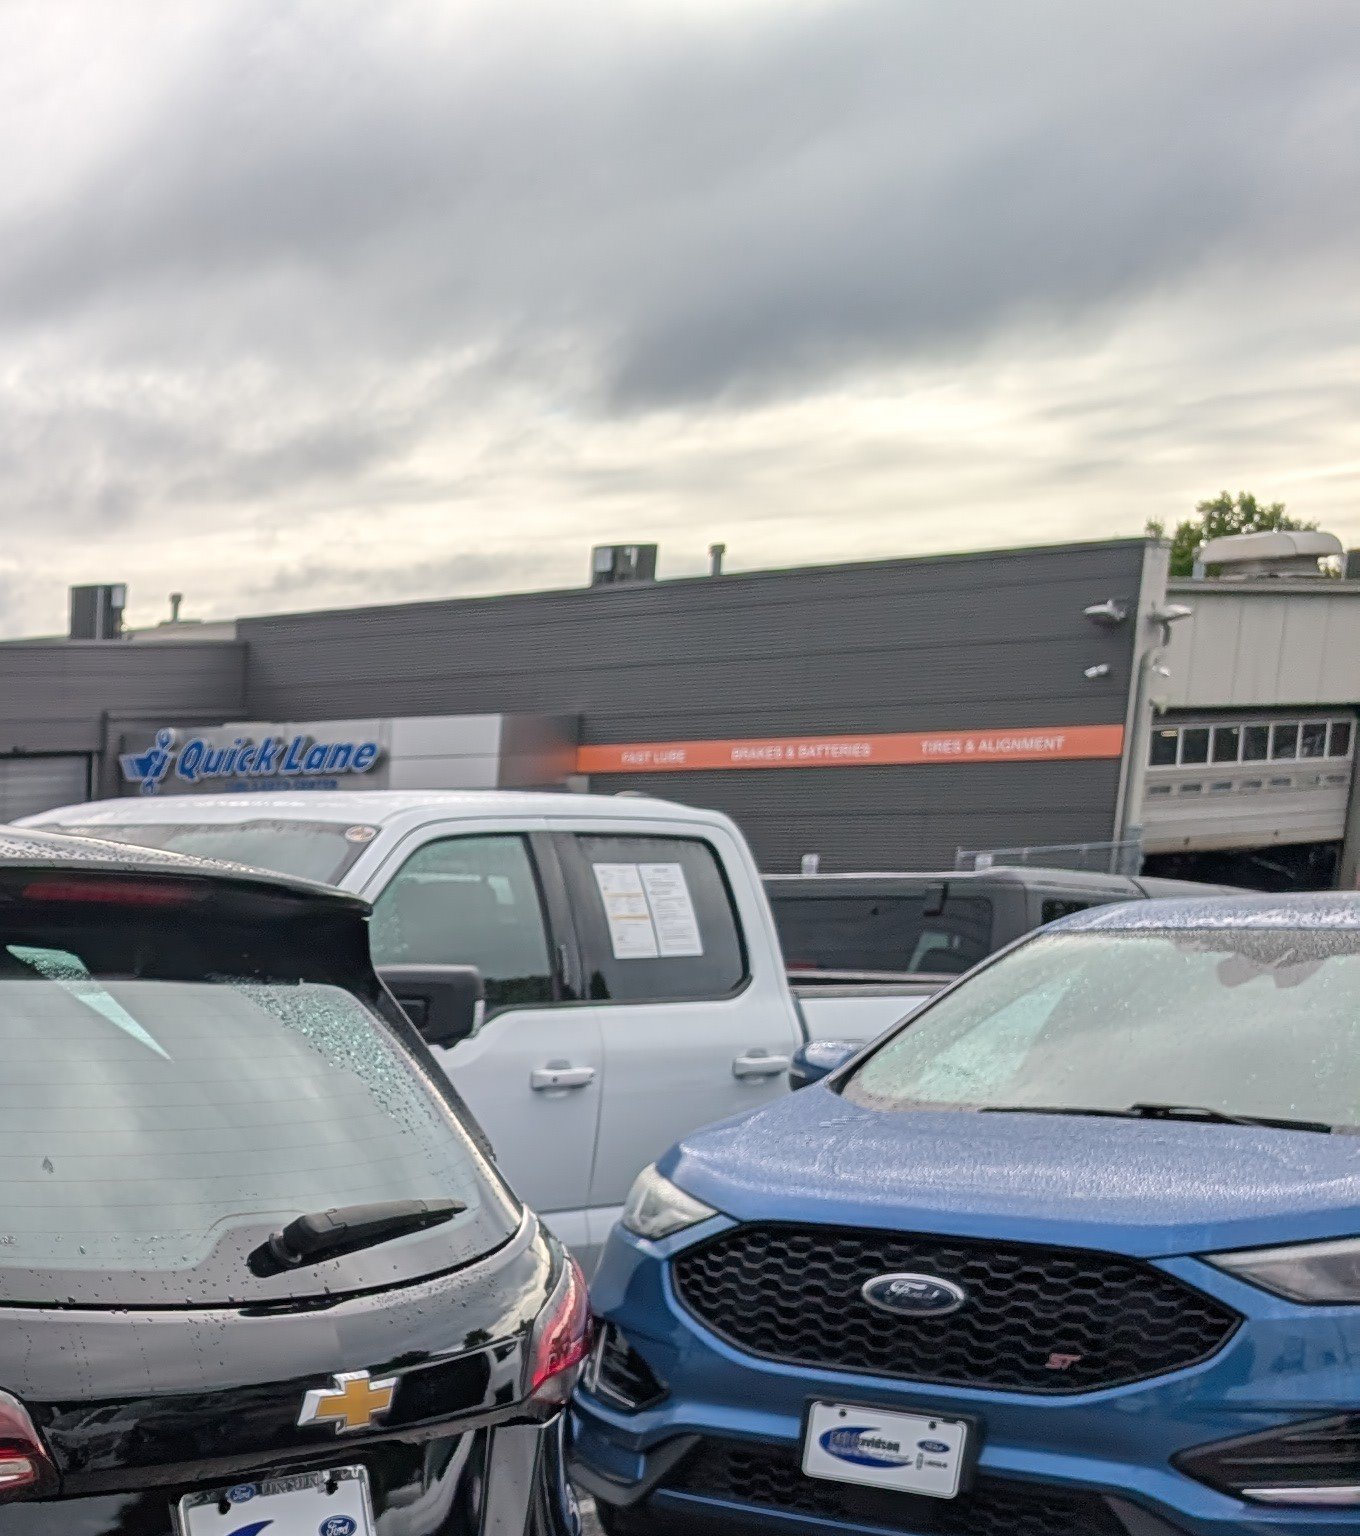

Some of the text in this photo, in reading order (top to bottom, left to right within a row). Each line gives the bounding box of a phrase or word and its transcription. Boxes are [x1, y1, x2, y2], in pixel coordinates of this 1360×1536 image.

[730, 746, 781, 761] BRAKES
[798, 742, 872, 758] BATTERIES
[921, 735, 1066, 754] TIRES & ALIGNMENT
[177, 734, 379, 783] Quick Lane
[621, 749, 686, 764] FAST LUBE
